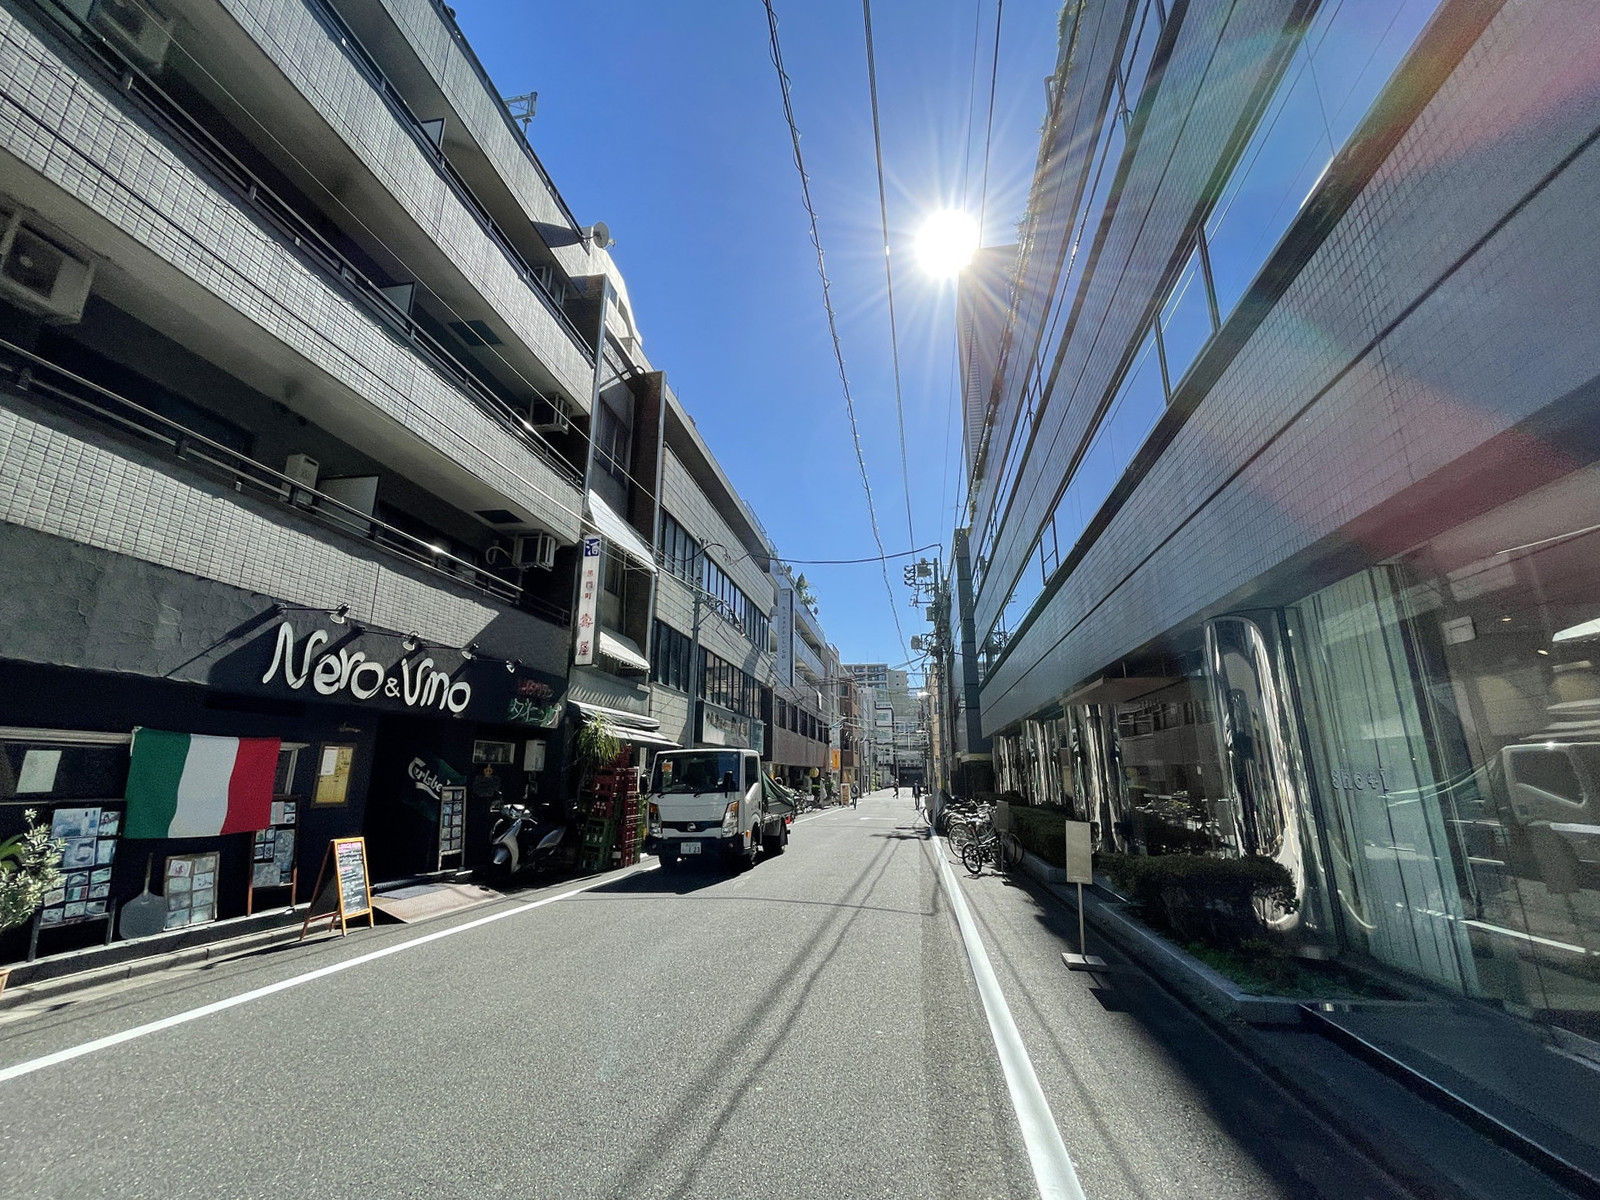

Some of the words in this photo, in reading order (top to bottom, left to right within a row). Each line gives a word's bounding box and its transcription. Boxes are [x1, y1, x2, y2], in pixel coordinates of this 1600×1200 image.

[262, 621, 385, 700] Nero
[384, 676, 401, 698] &
[401, 657, 471, 713] Vino
[407, 756, 452, 793] Carlsbe
